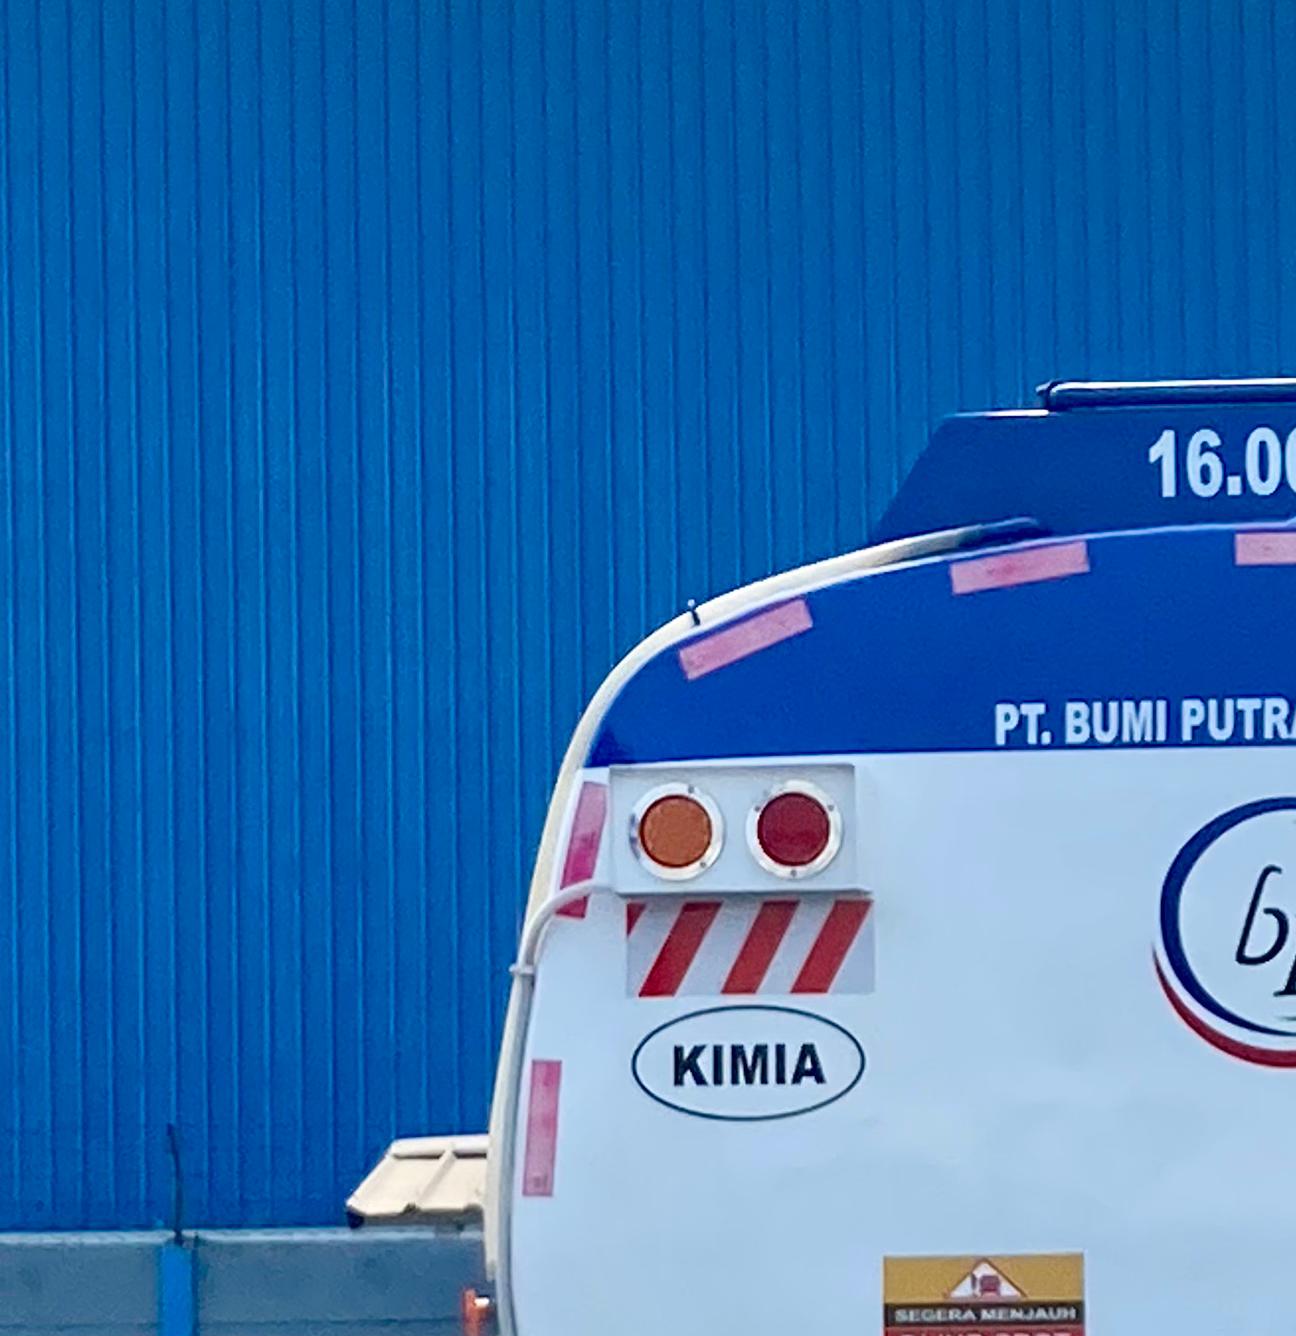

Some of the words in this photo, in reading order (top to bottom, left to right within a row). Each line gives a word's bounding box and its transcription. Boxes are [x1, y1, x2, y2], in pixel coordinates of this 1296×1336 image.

[994, 703, 1052, 746] PT.
[1065, 699, 1166, 744] BUMI
[672, 1043, 827, 1086] KIMIA
[895, 1308, 976, 1323] SEGERA
[980, 1306, 1077, 1321] MENJAUH
